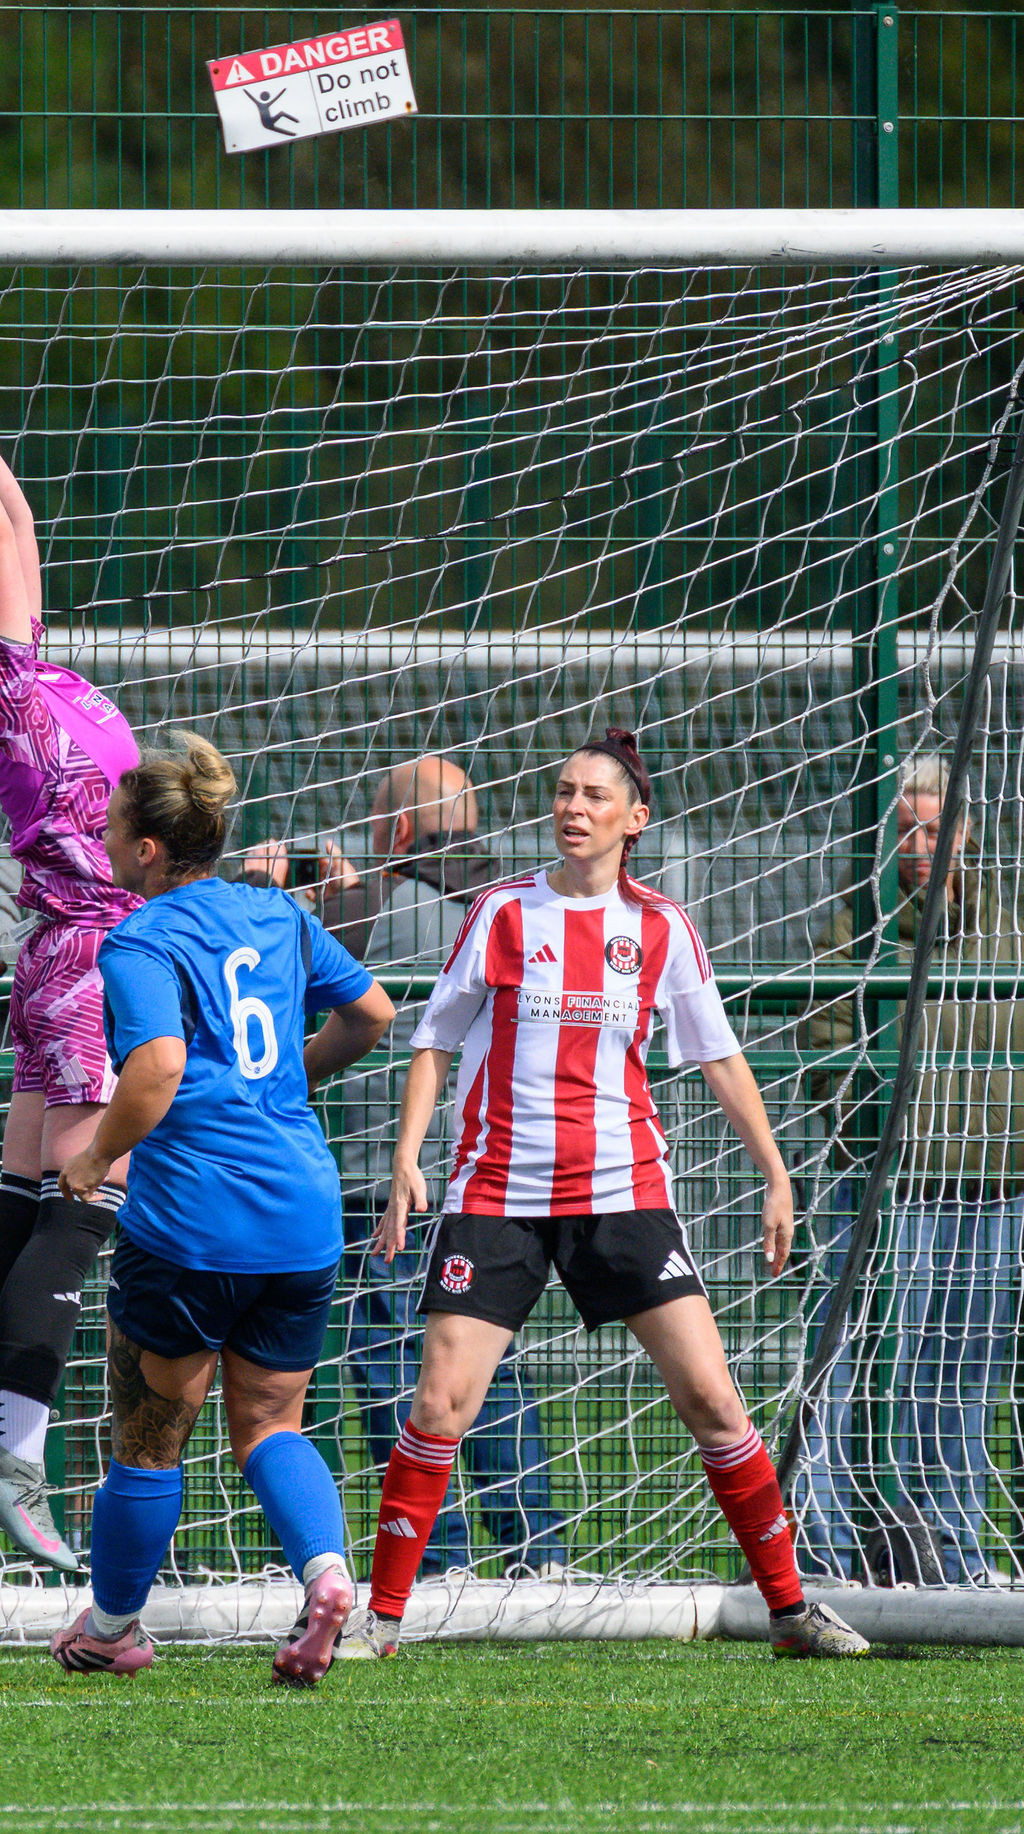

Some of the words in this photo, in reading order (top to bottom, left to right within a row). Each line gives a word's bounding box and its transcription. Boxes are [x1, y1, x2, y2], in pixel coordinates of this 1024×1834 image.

[260, 27, 392, 76] DANGER
[317, 73, 351, 94] Do
[360, 59, 400, 85] not
[325, 92, 391, 122] climb
[224, 947, 278, 1079] 6
[517, 993, 560, 1006] LYONS
[568, 996, 640, 1011] FINANCIAL
[530, 1008, 627, 1023] MANAGEMENT
